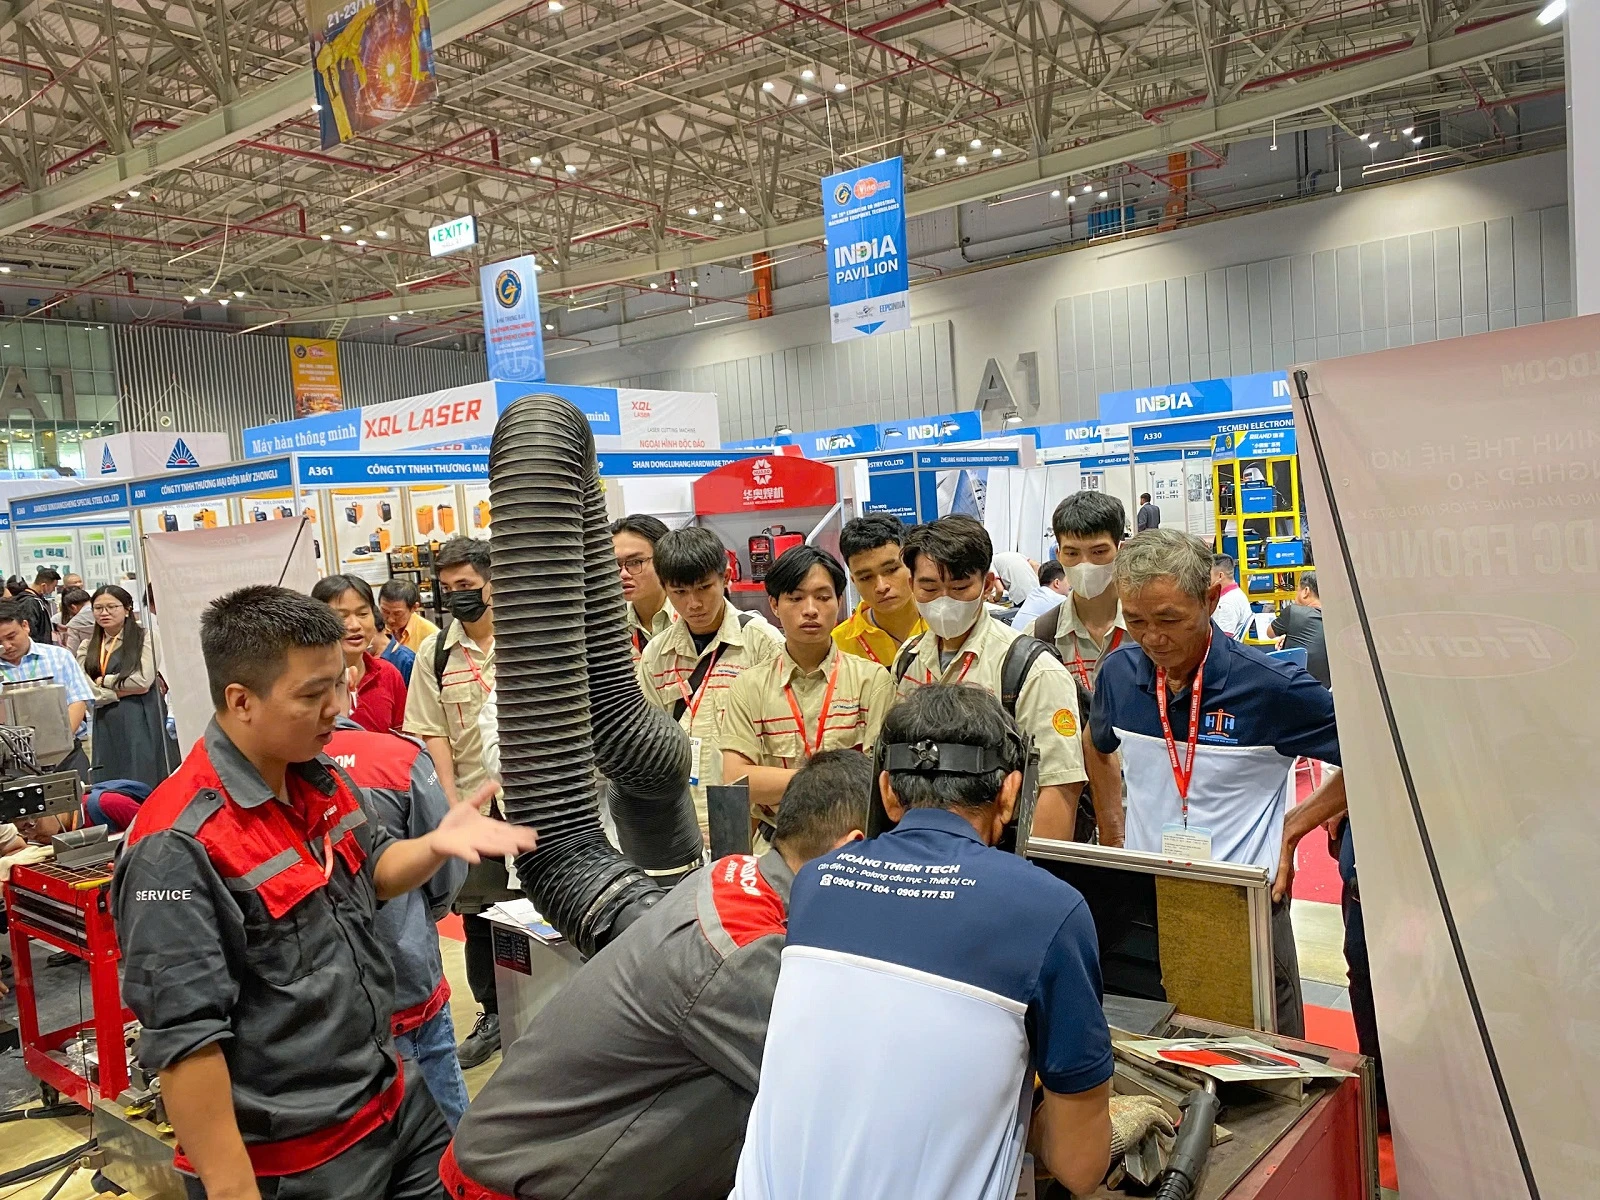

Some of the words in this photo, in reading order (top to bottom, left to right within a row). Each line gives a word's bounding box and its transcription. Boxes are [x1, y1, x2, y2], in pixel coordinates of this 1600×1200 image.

[438, 222, 462, 242] EXIT
[834, 234, 897, 268] INDIA
[836, 258, 898, 284] PAVILION
[974, 352, 1040, 412] A1
[632, 401, 652, 411] XQL
[1136, 392, 1193, 414] INDIA
[364, 414, 402, 439] XQL
[408, 399, 482, 431] LASER
[1218, 423, 1249, 433] TECMEN
[252, 438, 273, 454] Máy
[274, 433, 293, 449] hàn
[295, 428, 326, 447] thông
[328, 424, 357, 441] minh
[640, 440, 660, 450] NGOẠI
[661, 438, 678, 448] HÌNH
[816, 434, 855, 450] INDIA
[1065, 425, 1102, 440] INDIA
[308, 466, 333, 476] A361
[367, 462, 394, 475] CÔNG
[395, 465, 407, 474] TY
[408, 464, 434, 474] TNHH
[434, 462, 471, 473] THƯƠNG
[161, 483, 174, 495] CÔNG
[174, 483, 181, 493] TY
[181, 481, 194, 492] TNHH
[240, 470, 252, 483] MÁY
[253, 470, 277, 482] ZHONGLI
[135, 490, 146, 498] A361
[331, 754, 355, 768] OM
[860, 869, 888, 881] Palang
[925, 864, 960, 873] TECH
[136, 890, 192, 901] SERVICE
[833, 877, 855, 888] 0906
[856, 881, 872, 891] 777
[872, 885, 889, 894] 504
[897, 888, 920, 897] 0906
[921, 890, 939, 898] 777
[939, 891, 955, 899] 531
